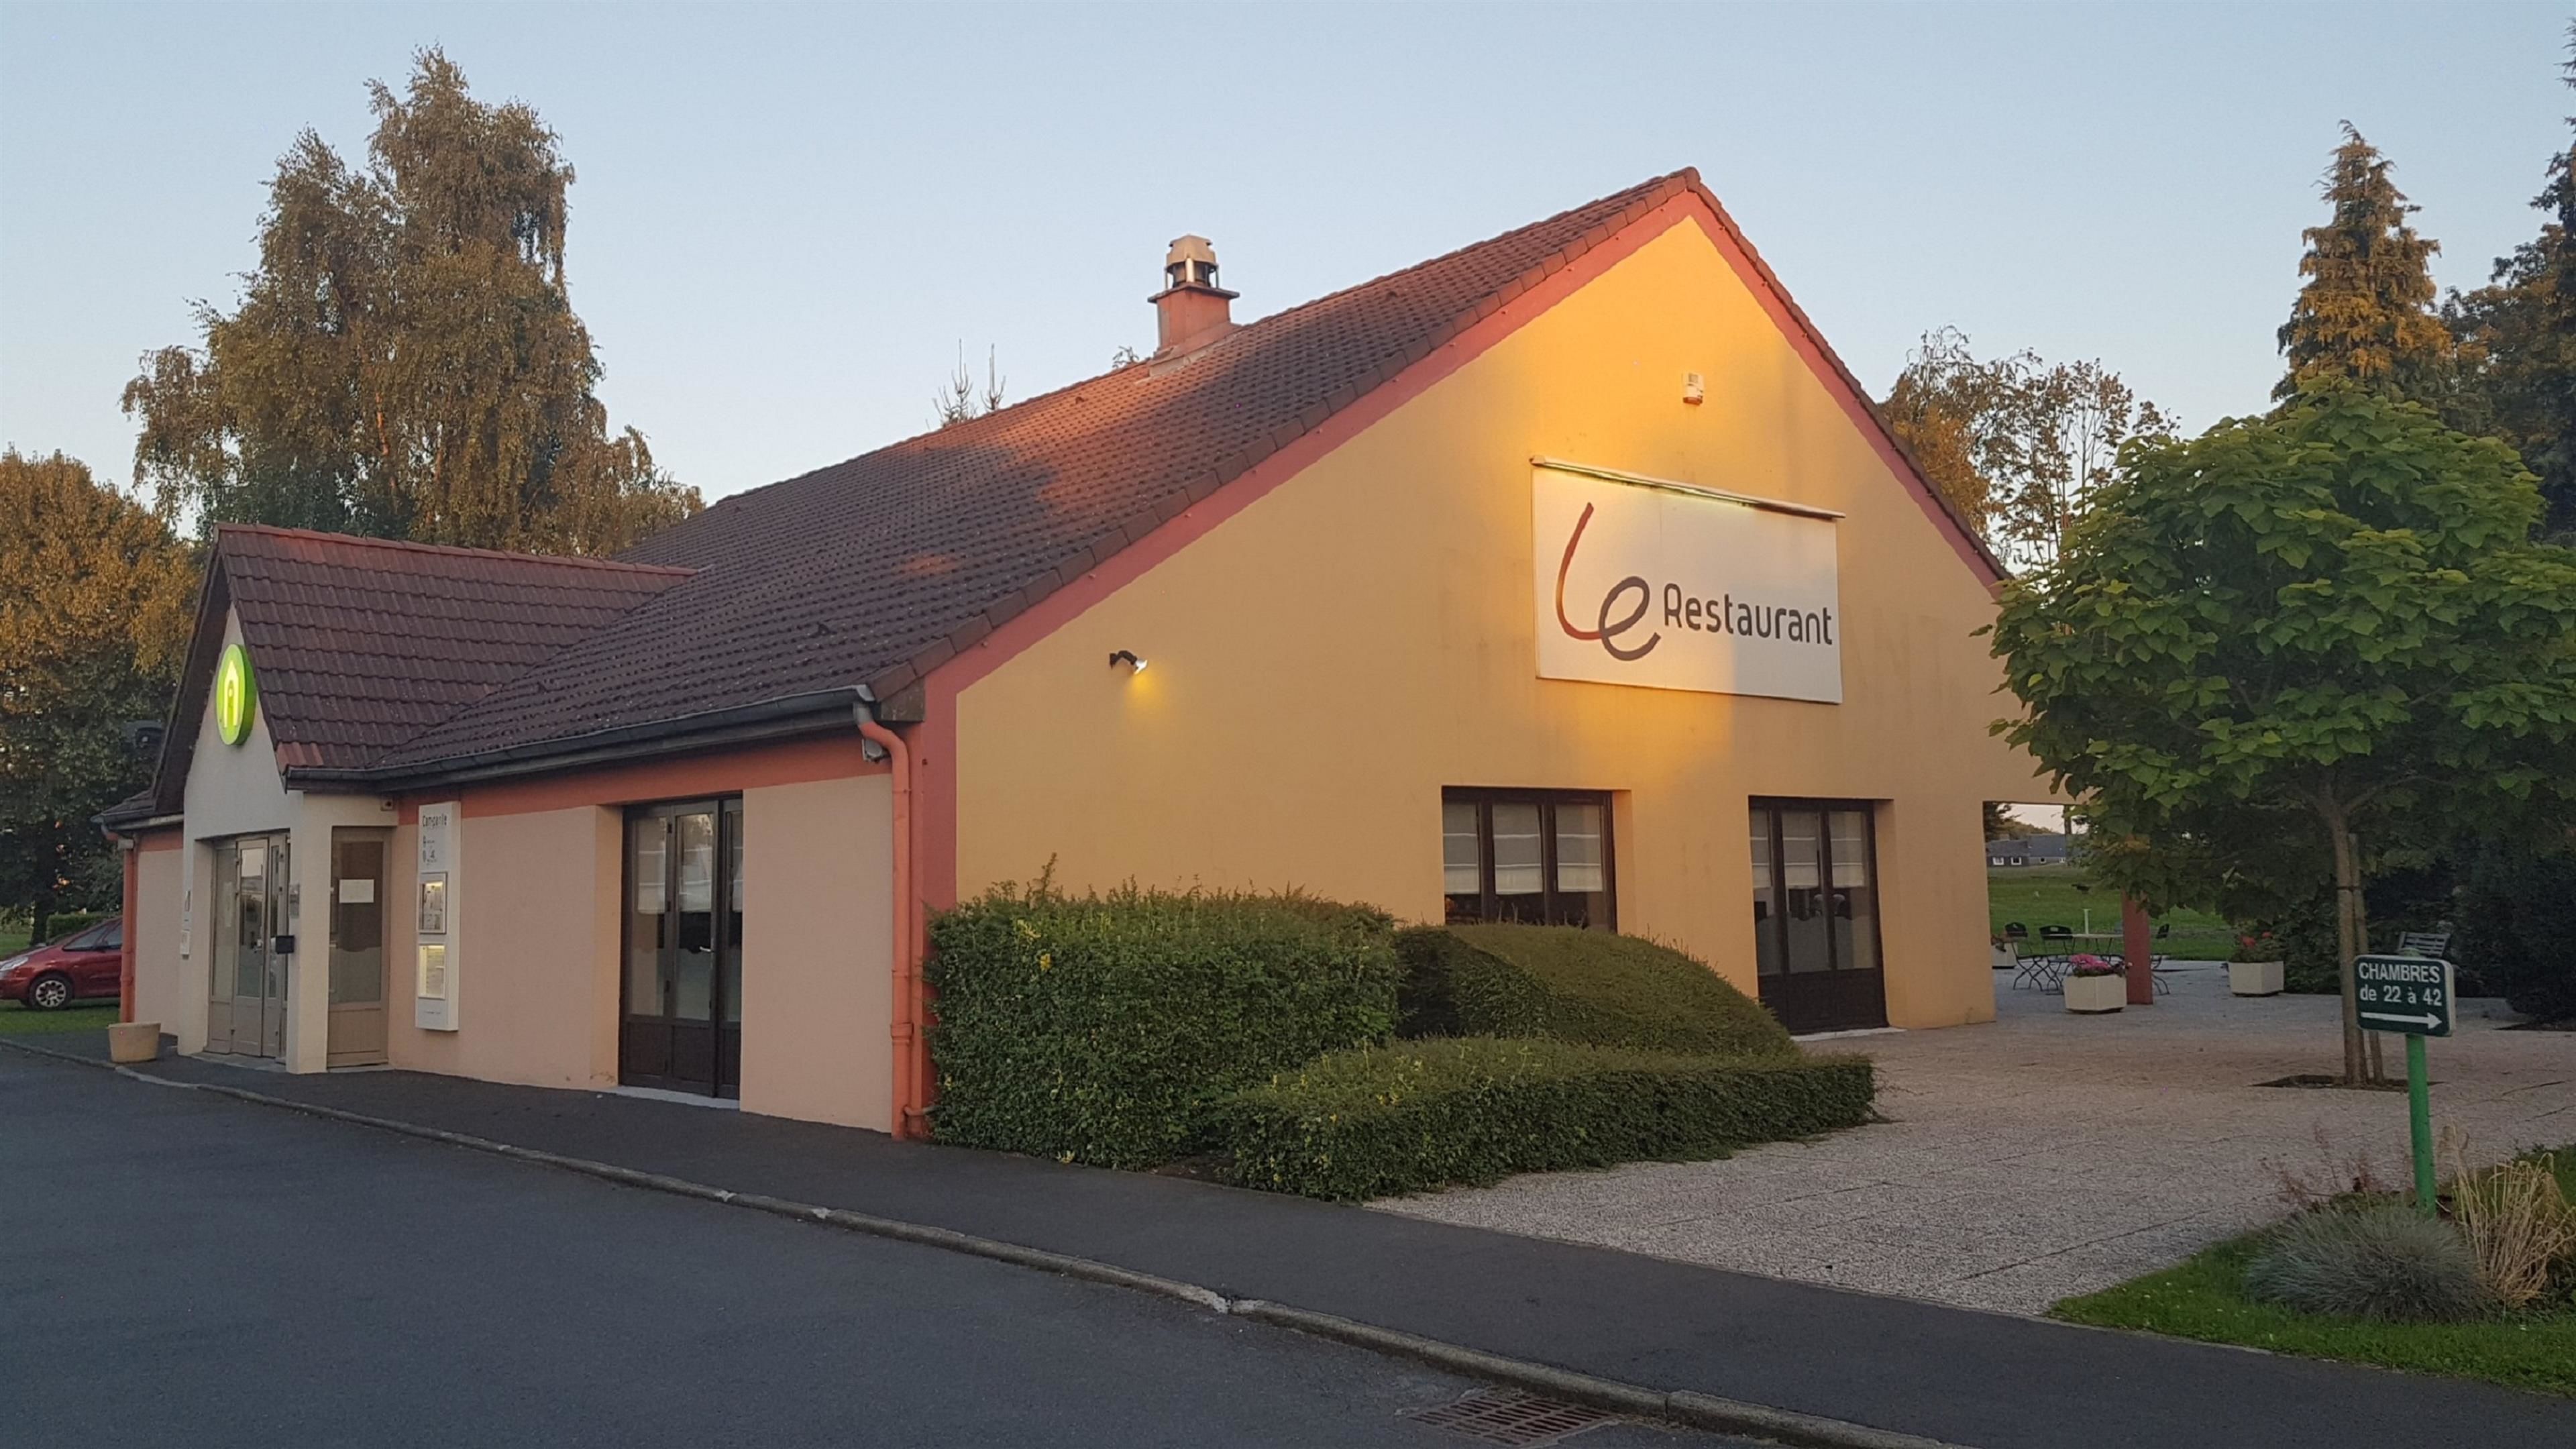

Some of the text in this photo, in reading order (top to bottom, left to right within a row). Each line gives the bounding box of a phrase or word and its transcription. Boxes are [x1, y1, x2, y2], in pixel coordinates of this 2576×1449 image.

[1556, 502, 1833, 661] Le Restaurant
[2358, 962, 2440, 983] CHAMBRES
[2359, 984, 2443, 1007] de 22 à 42
